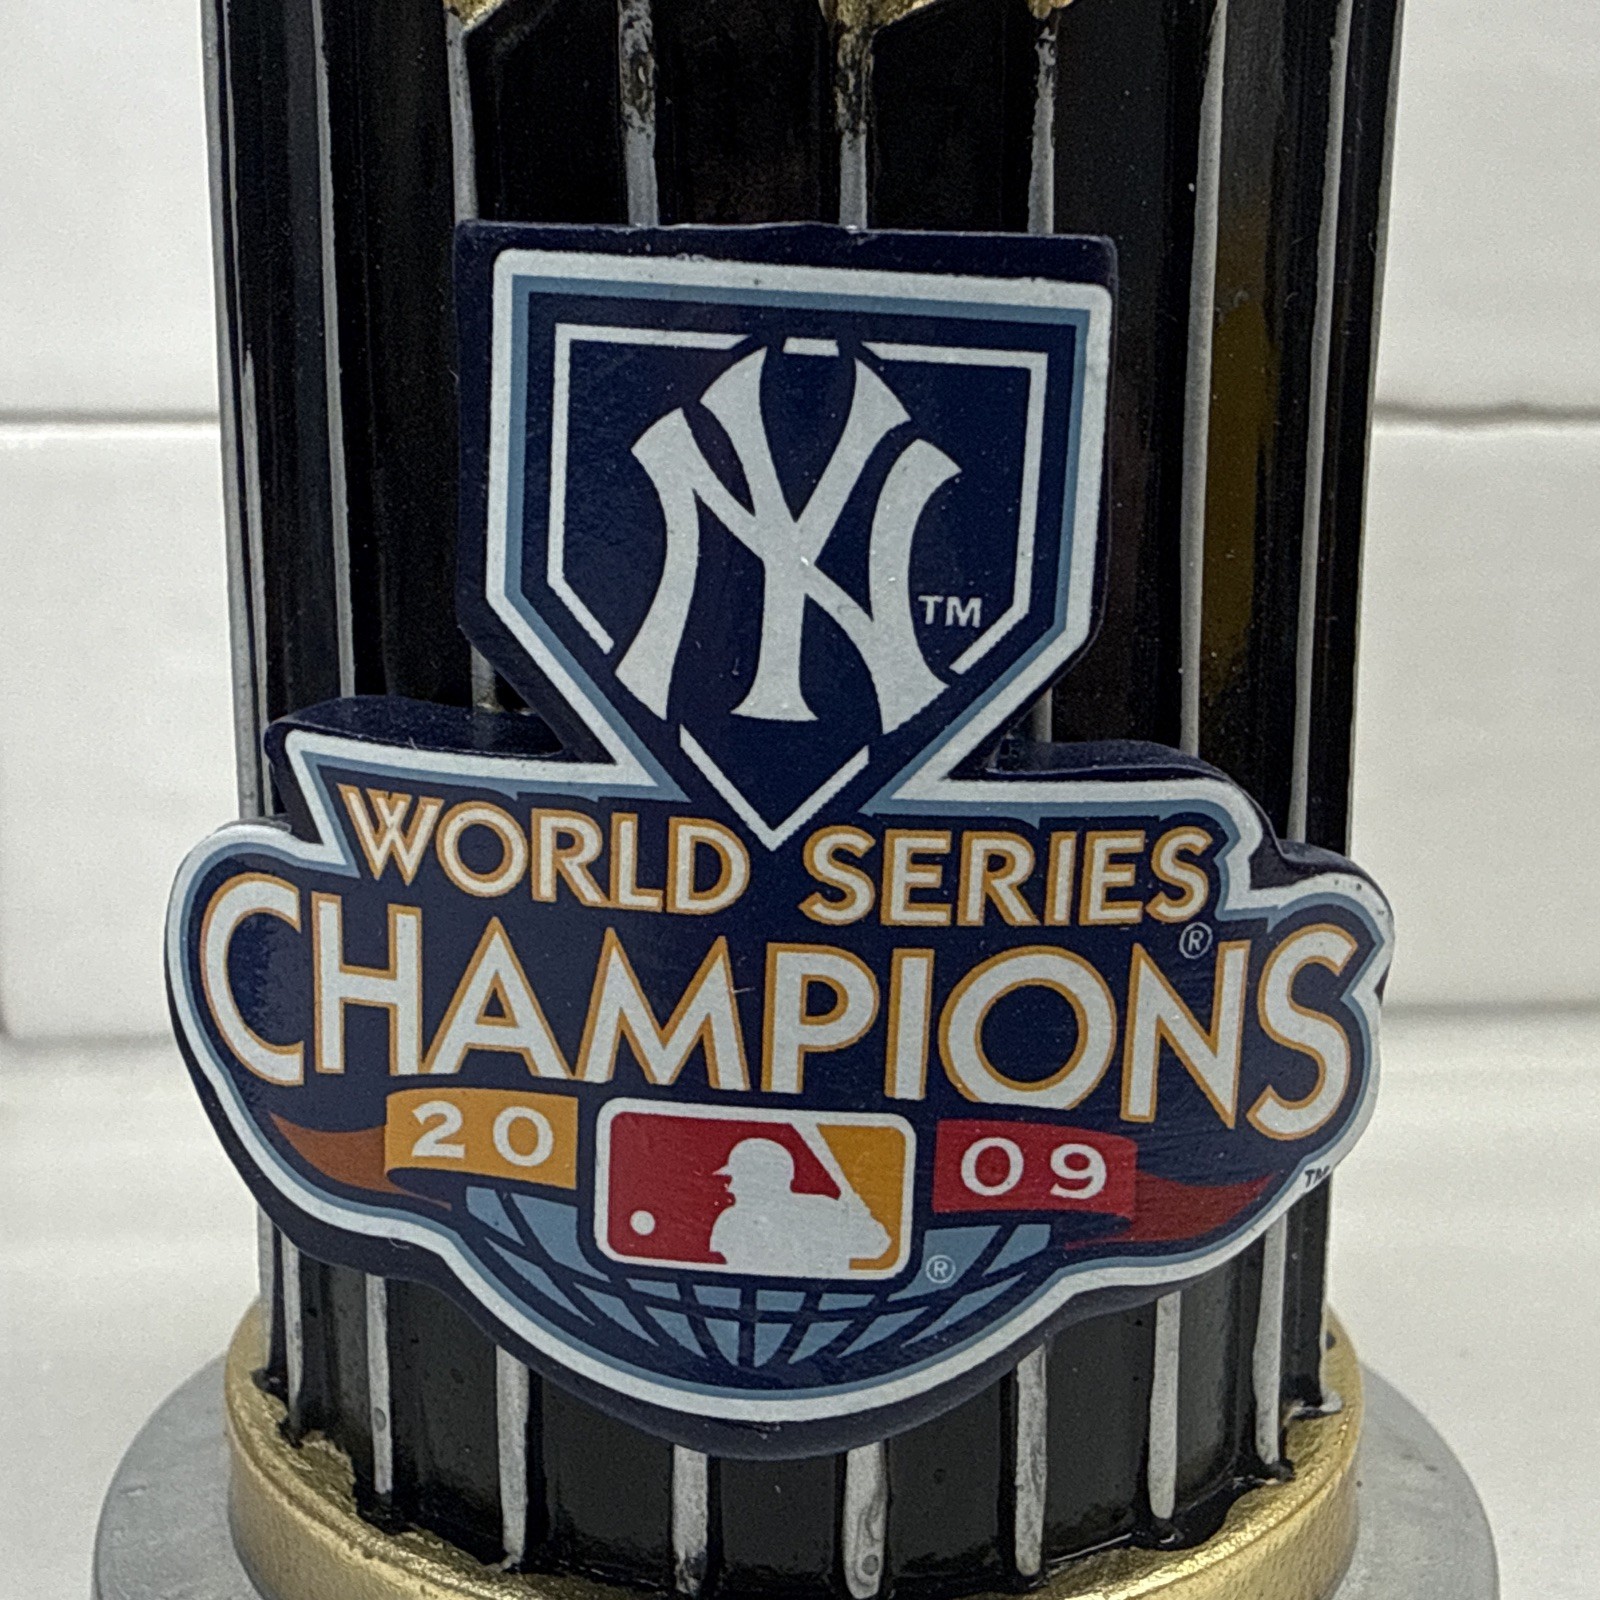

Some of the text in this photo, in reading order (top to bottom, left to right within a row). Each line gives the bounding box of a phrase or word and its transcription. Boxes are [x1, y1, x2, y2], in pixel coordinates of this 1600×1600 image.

[918, 595, 981, 628] TM
[338, 783, 1213, 927] WORLD SERIES
[201, 872, 1358, 1141] CHAMPIONS
